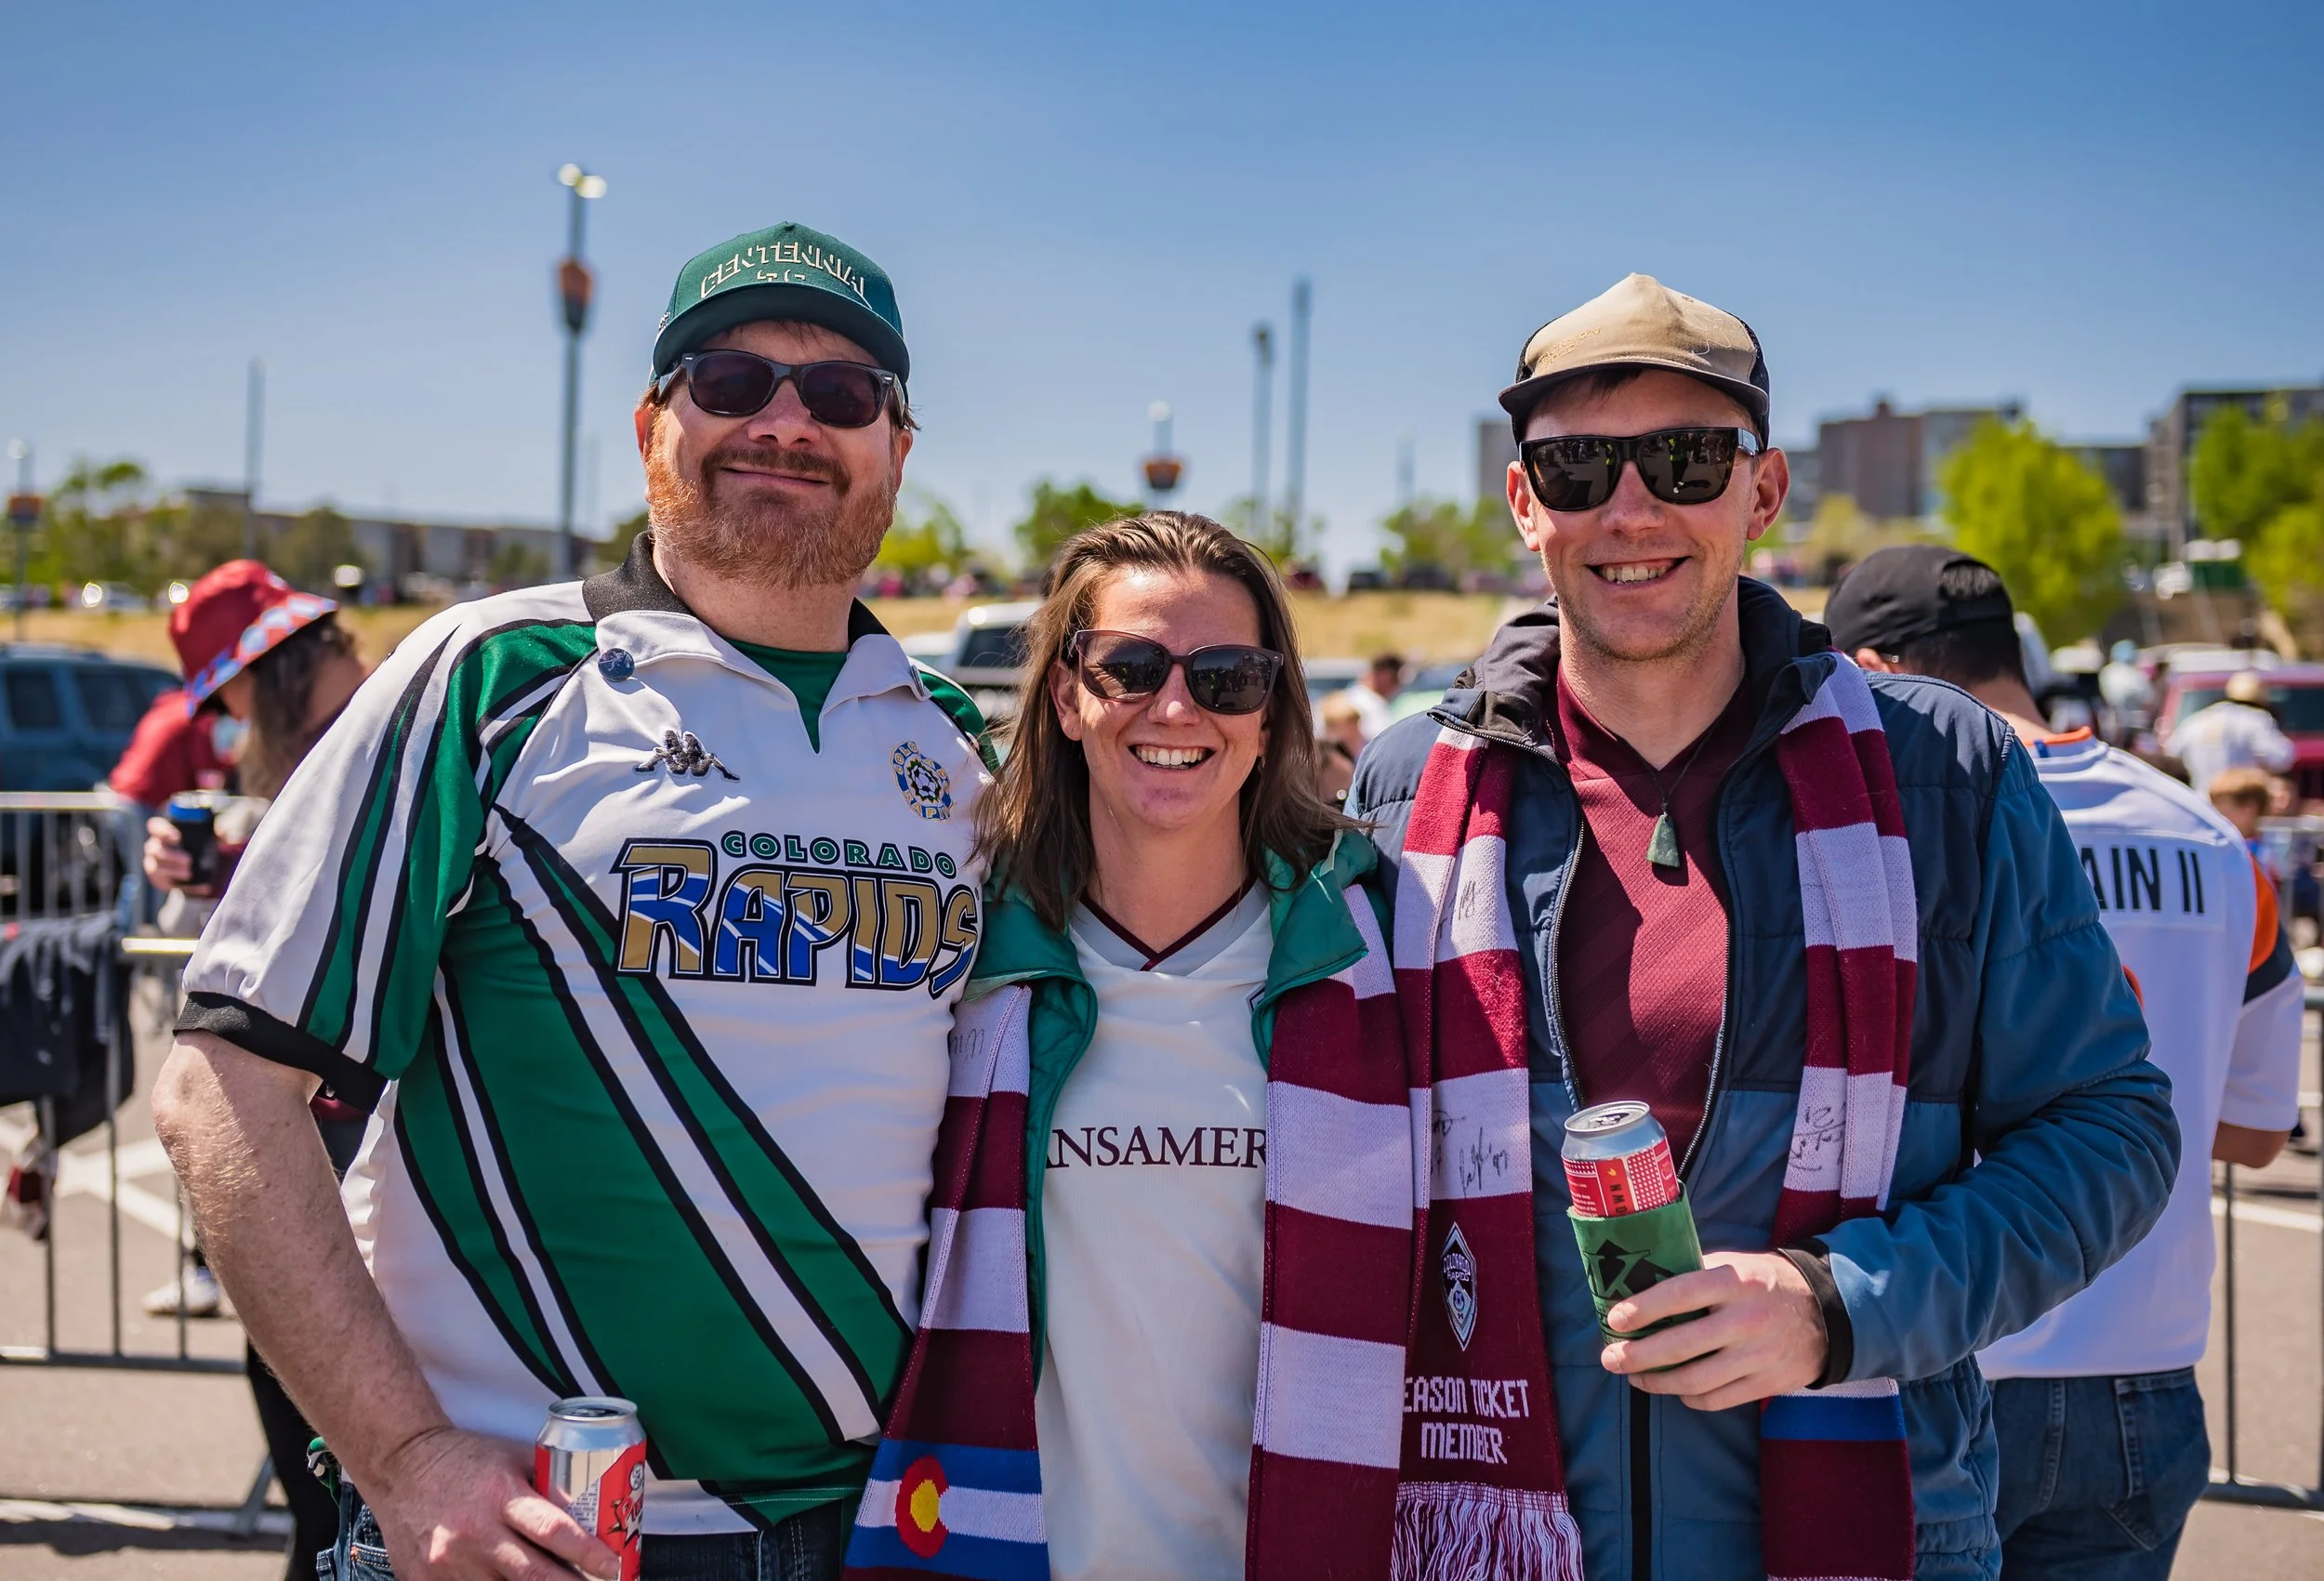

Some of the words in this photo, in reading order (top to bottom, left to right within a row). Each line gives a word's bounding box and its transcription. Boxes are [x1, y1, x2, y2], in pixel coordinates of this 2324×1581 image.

[721, 830, 957, 878] COLORADO
[2177, 850, 2205, 915] II
[609, 837, 978, 1000] RAPIDS
[1046, 1126, 1266, 1168] NSAMER
[1470, 1378, 1529, 1418] TICKET
[1420, 1421, 1508, 1465] MEMBER
